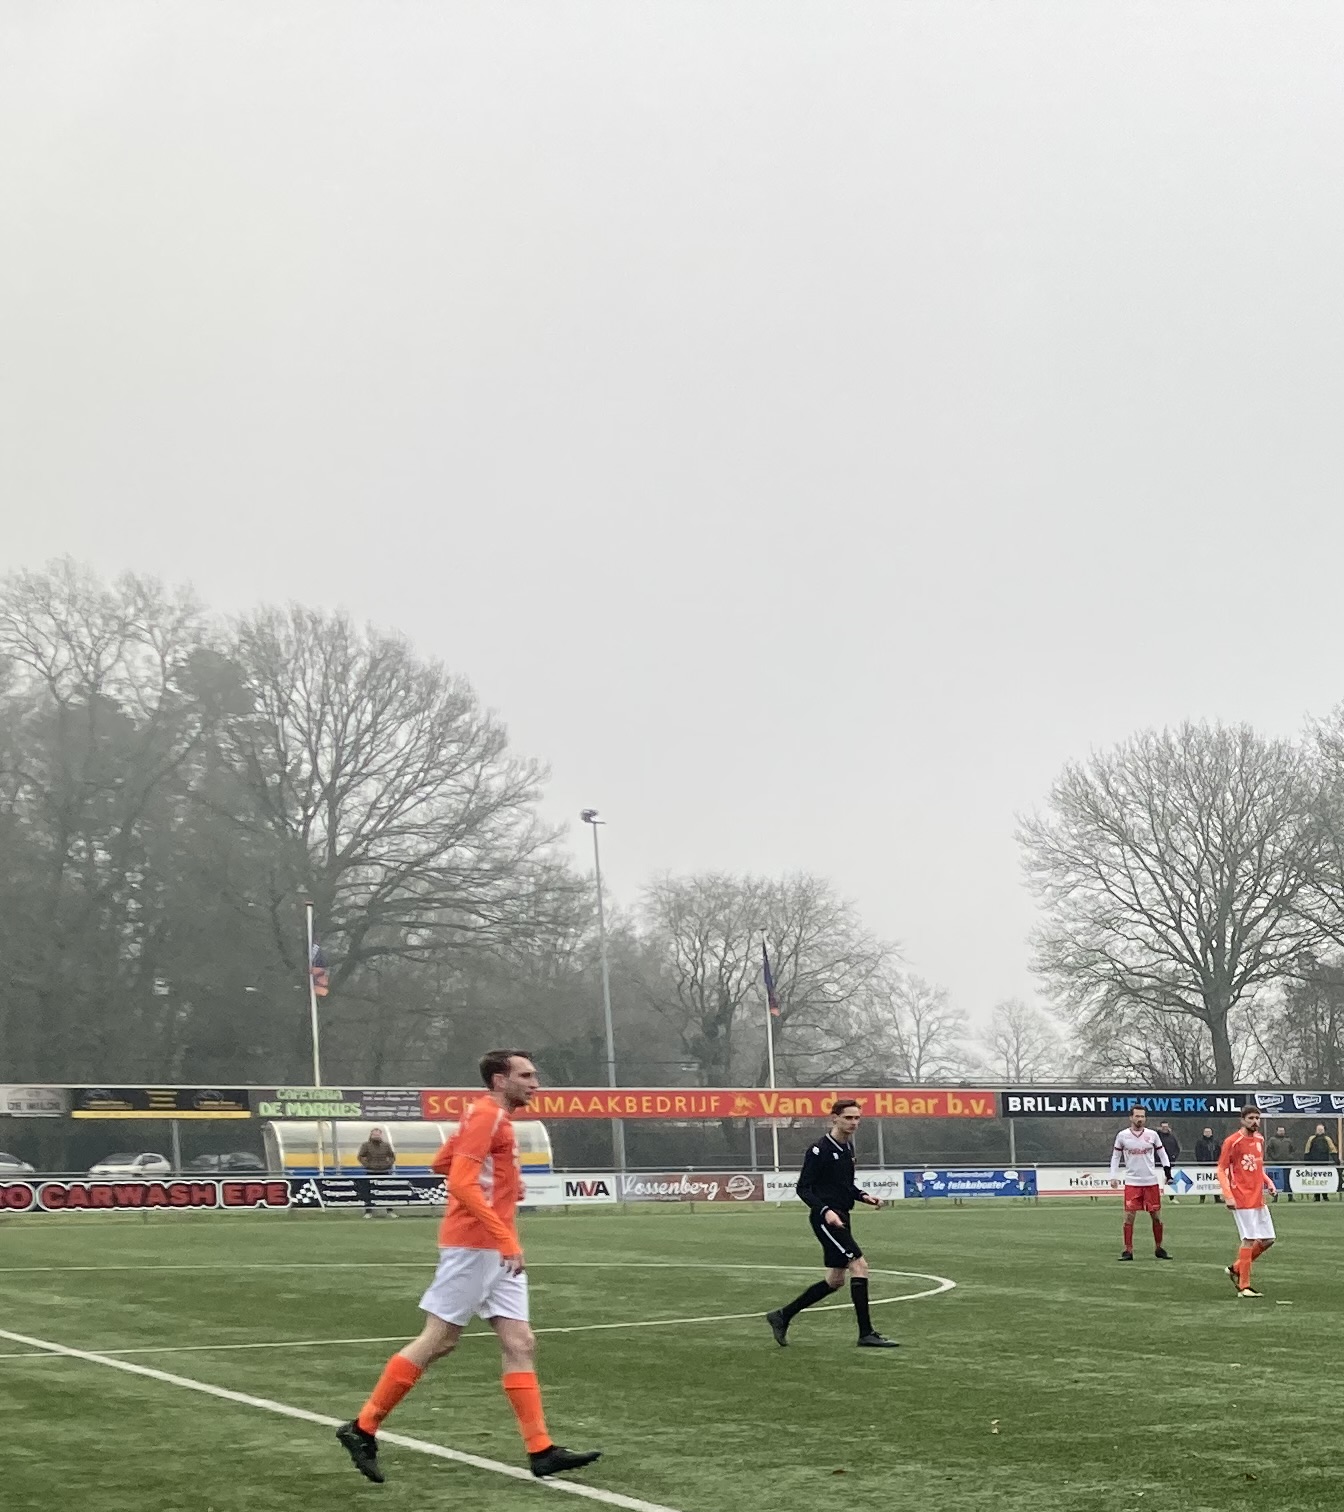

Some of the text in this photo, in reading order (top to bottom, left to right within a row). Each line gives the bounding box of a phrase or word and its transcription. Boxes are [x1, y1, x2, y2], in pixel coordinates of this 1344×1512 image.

[259, 1102, 282, 1116] DE
[286, 1102, 362, 1116] MARKIES
[428, 1096, 720, 1114] SCNMAAKBEDRIJF
[759, 1092, 812, 1114] Van
[821, 1092, 868, 1114] dr
[875, 1093, 938, 1114] Haar
[947, 1093, 993, 1114] b.v.
[41, 1184, 215, 1208] CARWASH
[223, 1183, 288, 1207] EPE
[565, 1181, 610, 1197] MVA
